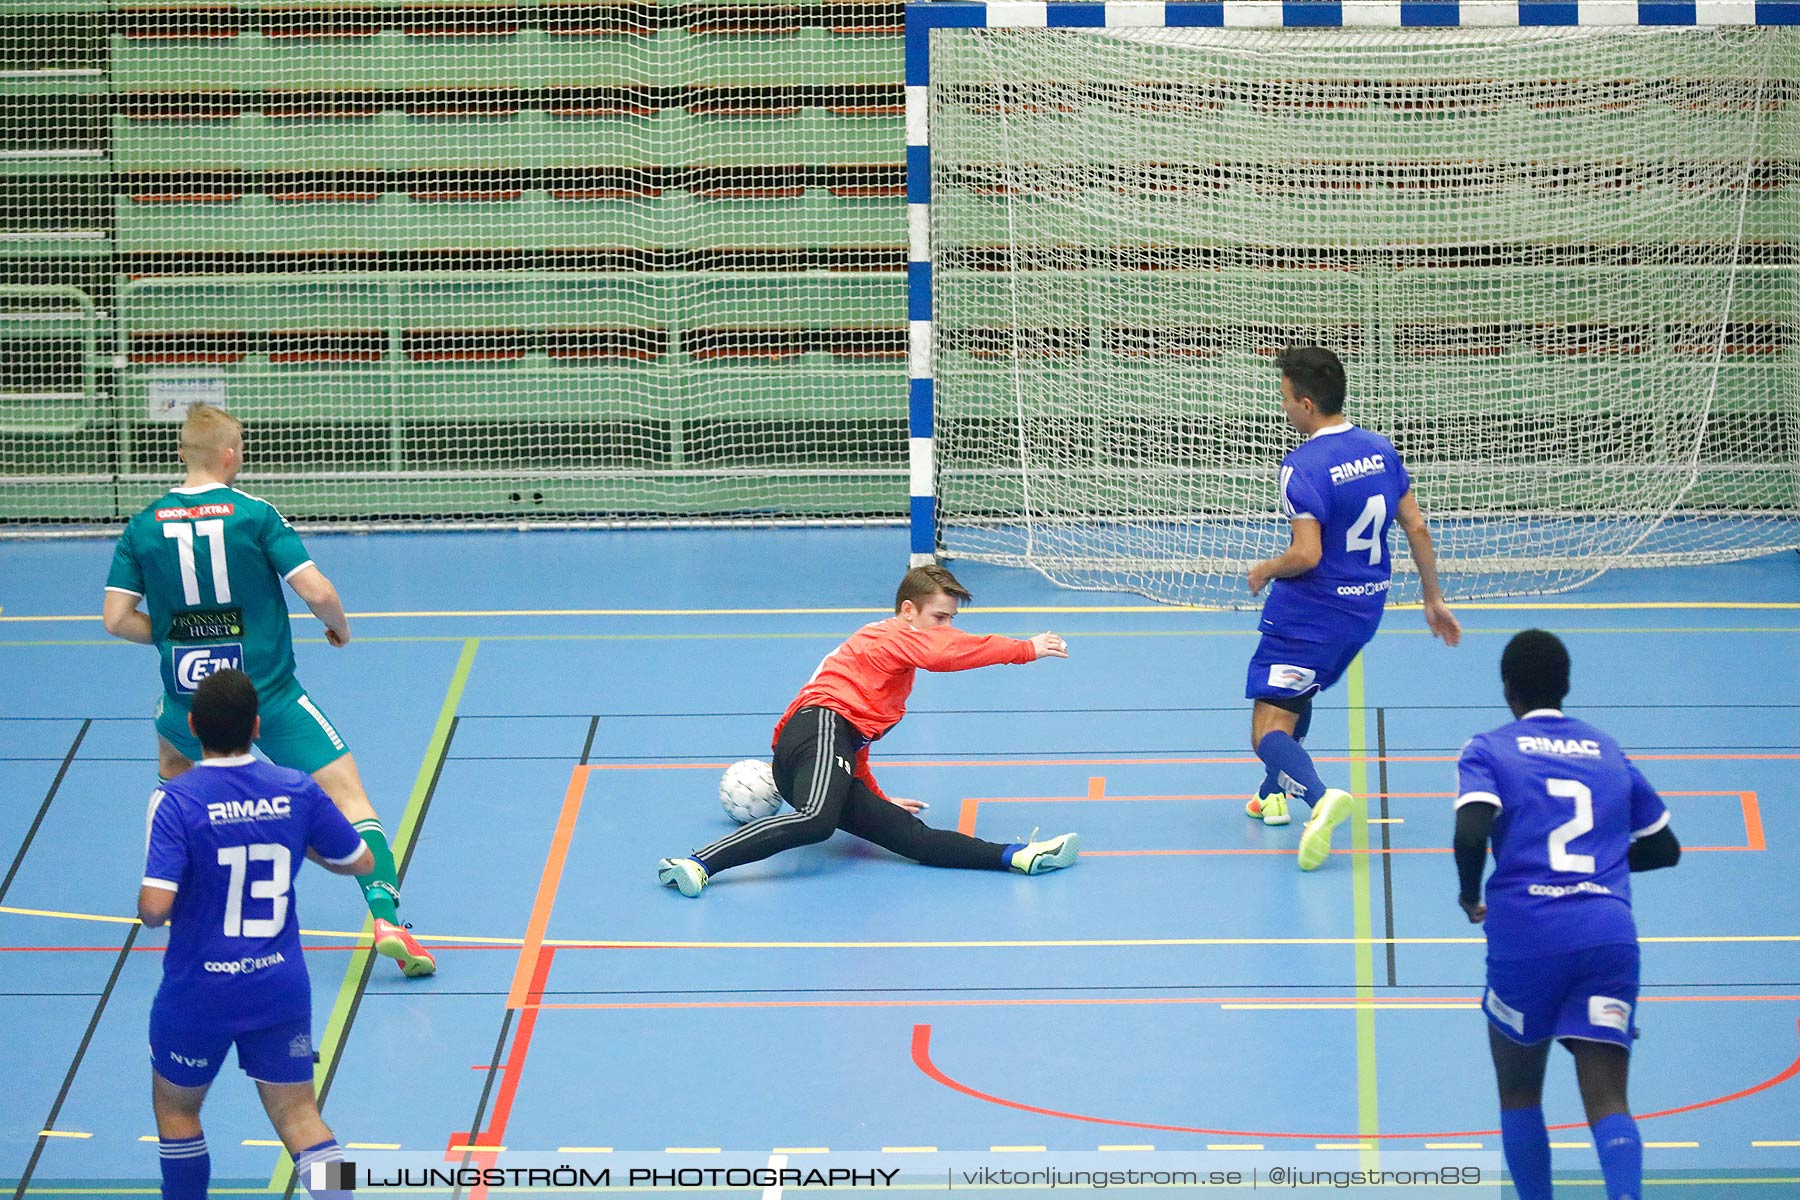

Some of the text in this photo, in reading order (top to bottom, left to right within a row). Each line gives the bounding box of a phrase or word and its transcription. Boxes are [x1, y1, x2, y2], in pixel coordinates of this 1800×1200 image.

[163, 519, 232, 606] 11
[1346, 494, 1387, 566] 4
[1546, 778, 1596, 874] 2
[218, 843, 291, 938] 13
[204, 961, 241, 975] coop
